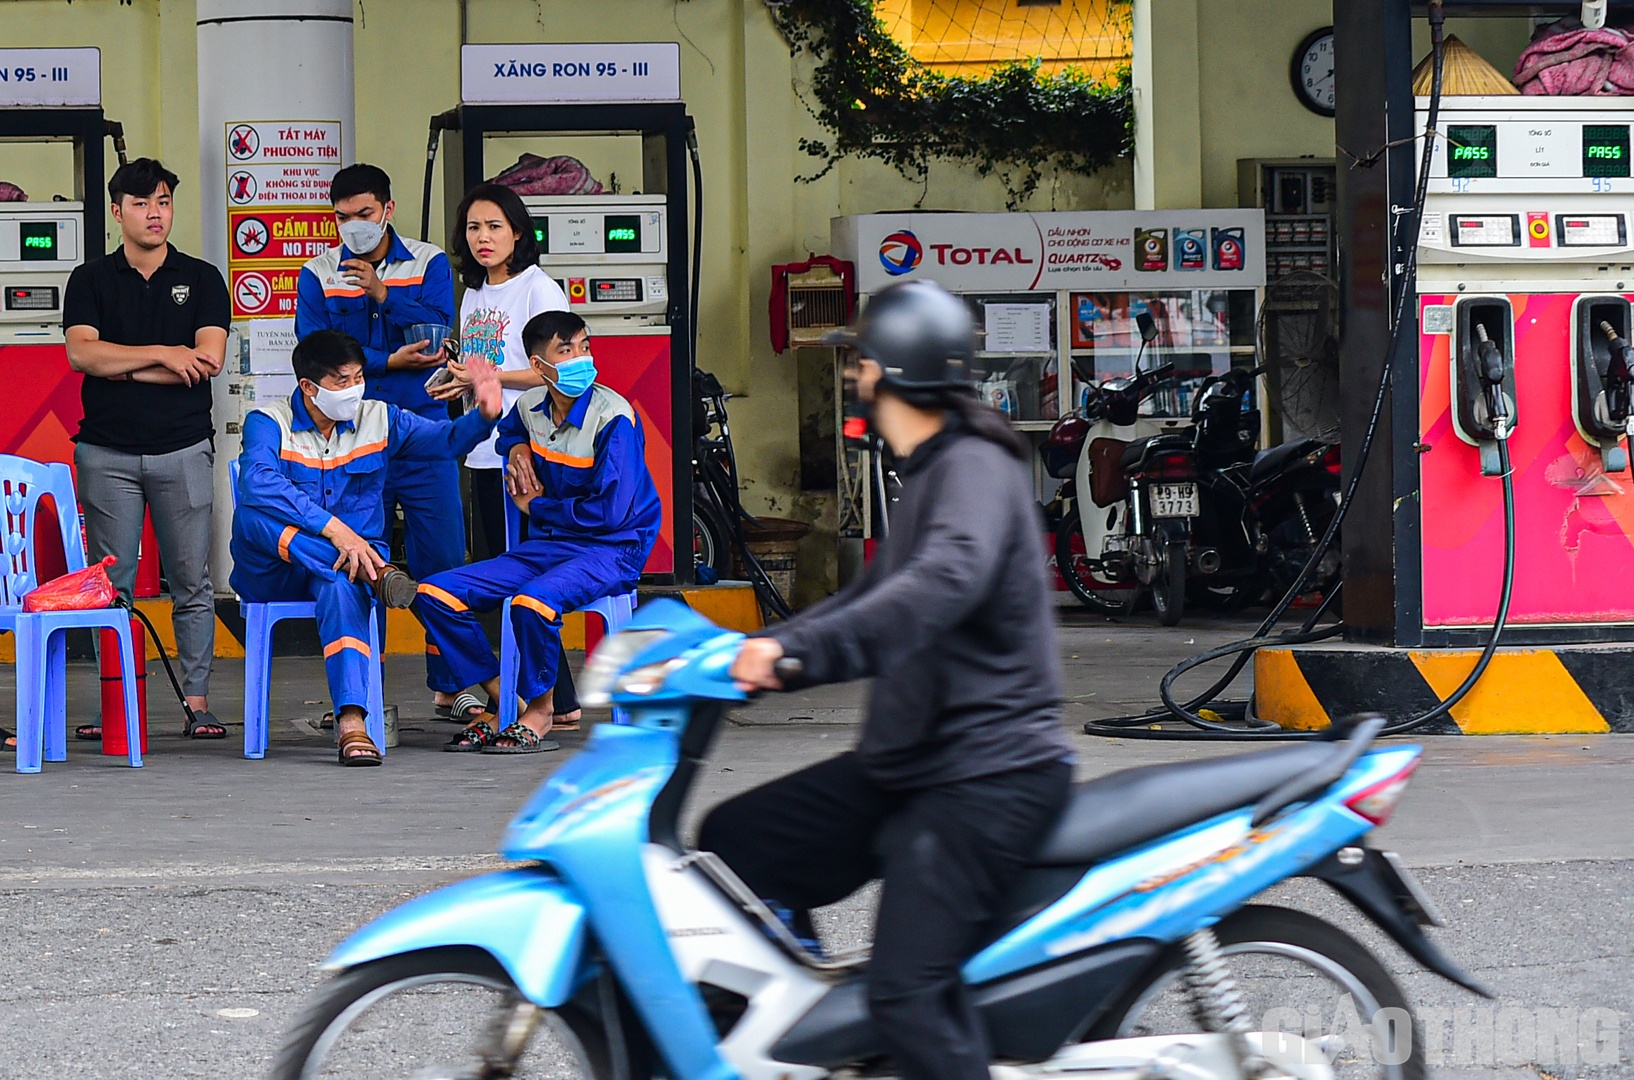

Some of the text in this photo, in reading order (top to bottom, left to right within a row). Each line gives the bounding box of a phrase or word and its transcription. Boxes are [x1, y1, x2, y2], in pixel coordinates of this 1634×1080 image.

[1320, 43, 1327, 51] 11
[1309, 52, 1318, 61] 10
[14, 67, 36, 82] 95
[52, 67, 68, 81] III
[494, 59, 547, 77] XĂNG
[552, 62, 590, 77] RON
[596, 62, 617, 76] 95
[632, 62, 648, 76] III
[1304, 65, 1310, 74] 9
[1307, 78, 1313, 87] 8
[1316, 89, 1322, 98] 7
[278, 127, 327, 140] TẮT MÁY
[263, 145, 338, 159] PHƯƠNG TIỆN
[1454, 144, 1489, 160] PASS
[1588, 145, 1622, 159] PASS
[304, 169, 320, 177] VỰC
[265, 179, 298, 188] KHÔNG
[1452, 177, 1470, 192] 92
[1592, 177, 1611, 192] 95
[280, 192, 307, 201] THOẠI
[272, 216, 337, 237] CẤM LỬA
[609, 229, 635, 241] PASS
[25, 236, 52, 248] PASS
[283, 242, 302, 256] NO
[930, 244, 1033, 265] TOTAL
[1048, 253, 1101, 265] QUARTZ
[271, 271, 293, 290] CẤM
[279, 298, 292, 311] NO
[1159, 500, 1192, 513] 3773
